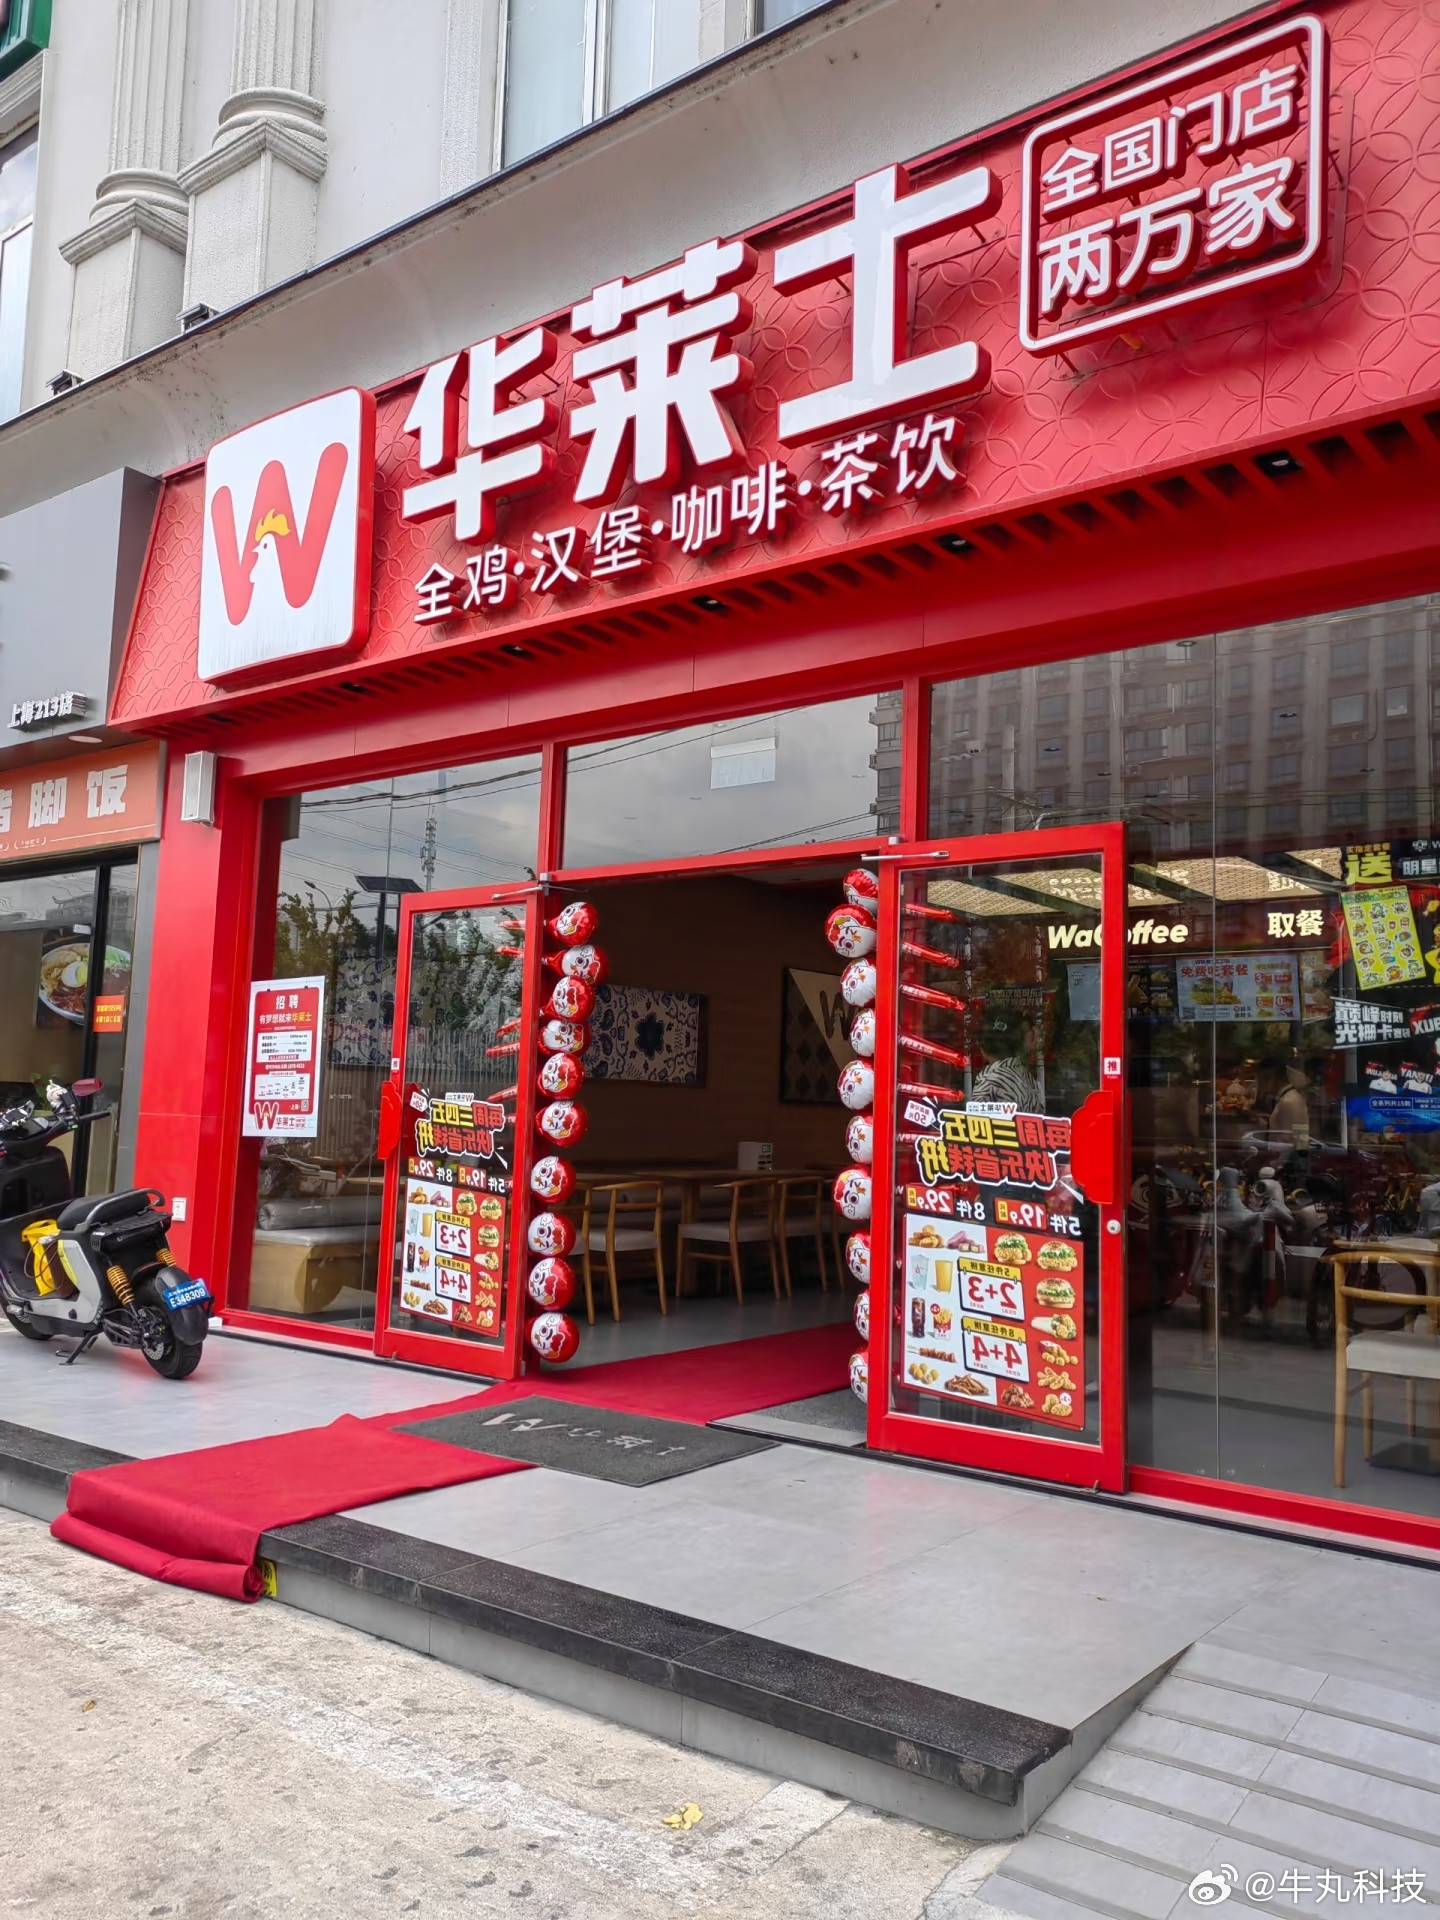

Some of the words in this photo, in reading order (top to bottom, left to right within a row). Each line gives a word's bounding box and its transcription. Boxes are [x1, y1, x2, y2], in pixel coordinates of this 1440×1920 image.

[1041, 66, 1298, 214] 全国门店
[1039, 156, 1297, 314] 两万家
[403, 163, 992, 542] 华莱士
[211, 441, 349, 626] W
[7, 691, 74, 728] 上海213店
[1344, 851, 1393, 885] 送
[1402, 858, 1440, 876] 明星
[1048, 919, 1189, 949] Waffee
[1267, 909, 1324, 938] 取餐
[275, 994, 299, 1010] 招聘
[1335, 1000, 1404, 1024] 巅峰时刻
[259, 1012, 313, 1025] 有梦想就来华莱士
[1107, 1060, 1118, 1072] 推
[170, 1287, 206, 1308] E348309
